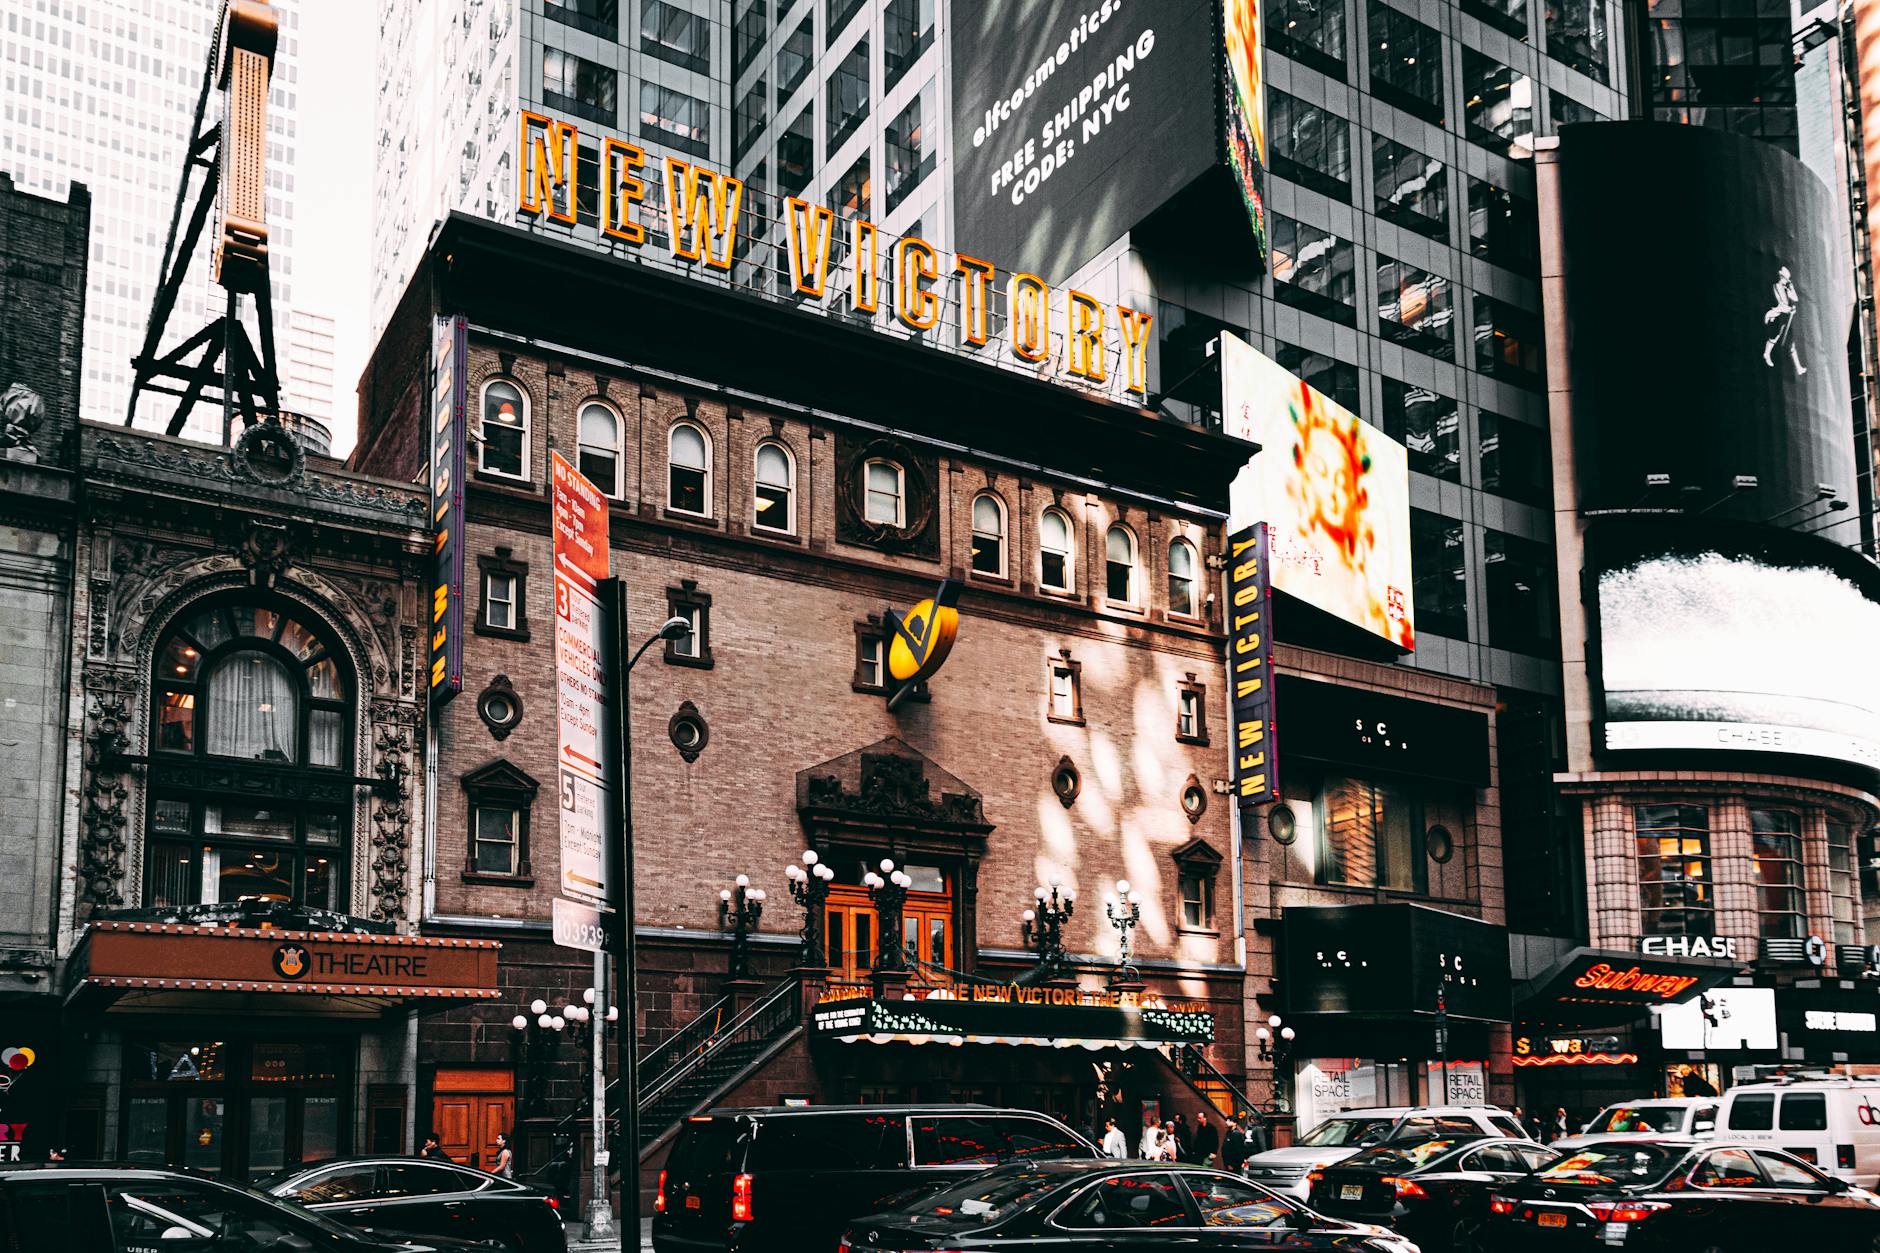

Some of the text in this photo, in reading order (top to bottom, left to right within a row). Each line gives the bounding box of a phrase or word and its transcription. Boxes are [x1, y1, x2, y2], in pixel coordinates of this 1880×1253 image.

[991, 29, 1155, 196] FREE SHIPPING
[1011, 82, 1130, 206] CODE: NYC
[517, 109, 1153, 394] NEW VICTORY
[555, 460, 601, 512] NO STANDING
[432, 339, 452, 688] NEW VICTORY
[556, 515, 575, 541] Except
[558, 583, 568, 617] 3
[559, 626, 602, 666] COMMERCIAL
[560, 646, 591, 677] VEHICLES
[1232, 536, 1265, 797] NEW VICTORY
[1718, 728, 1782, 746] CHASE
[562, 774, 574, 809] 5
[314, 951, 427, 978] THEATRE
[1642, 937, 1737, 959] CHASE
[937, 983, 969, 1001] THE
[973, 984, 1012, 1003] NEW
[1013, 986, 1084, 1006] VICTORY
[1574, 962, 1698, 998] Subway
[1314, 1084, 1350, 1098] SPACE
[1449, 1074, 1482, 1086] RETAIL
[1450, 1087, 1483, 1100] SPACE
